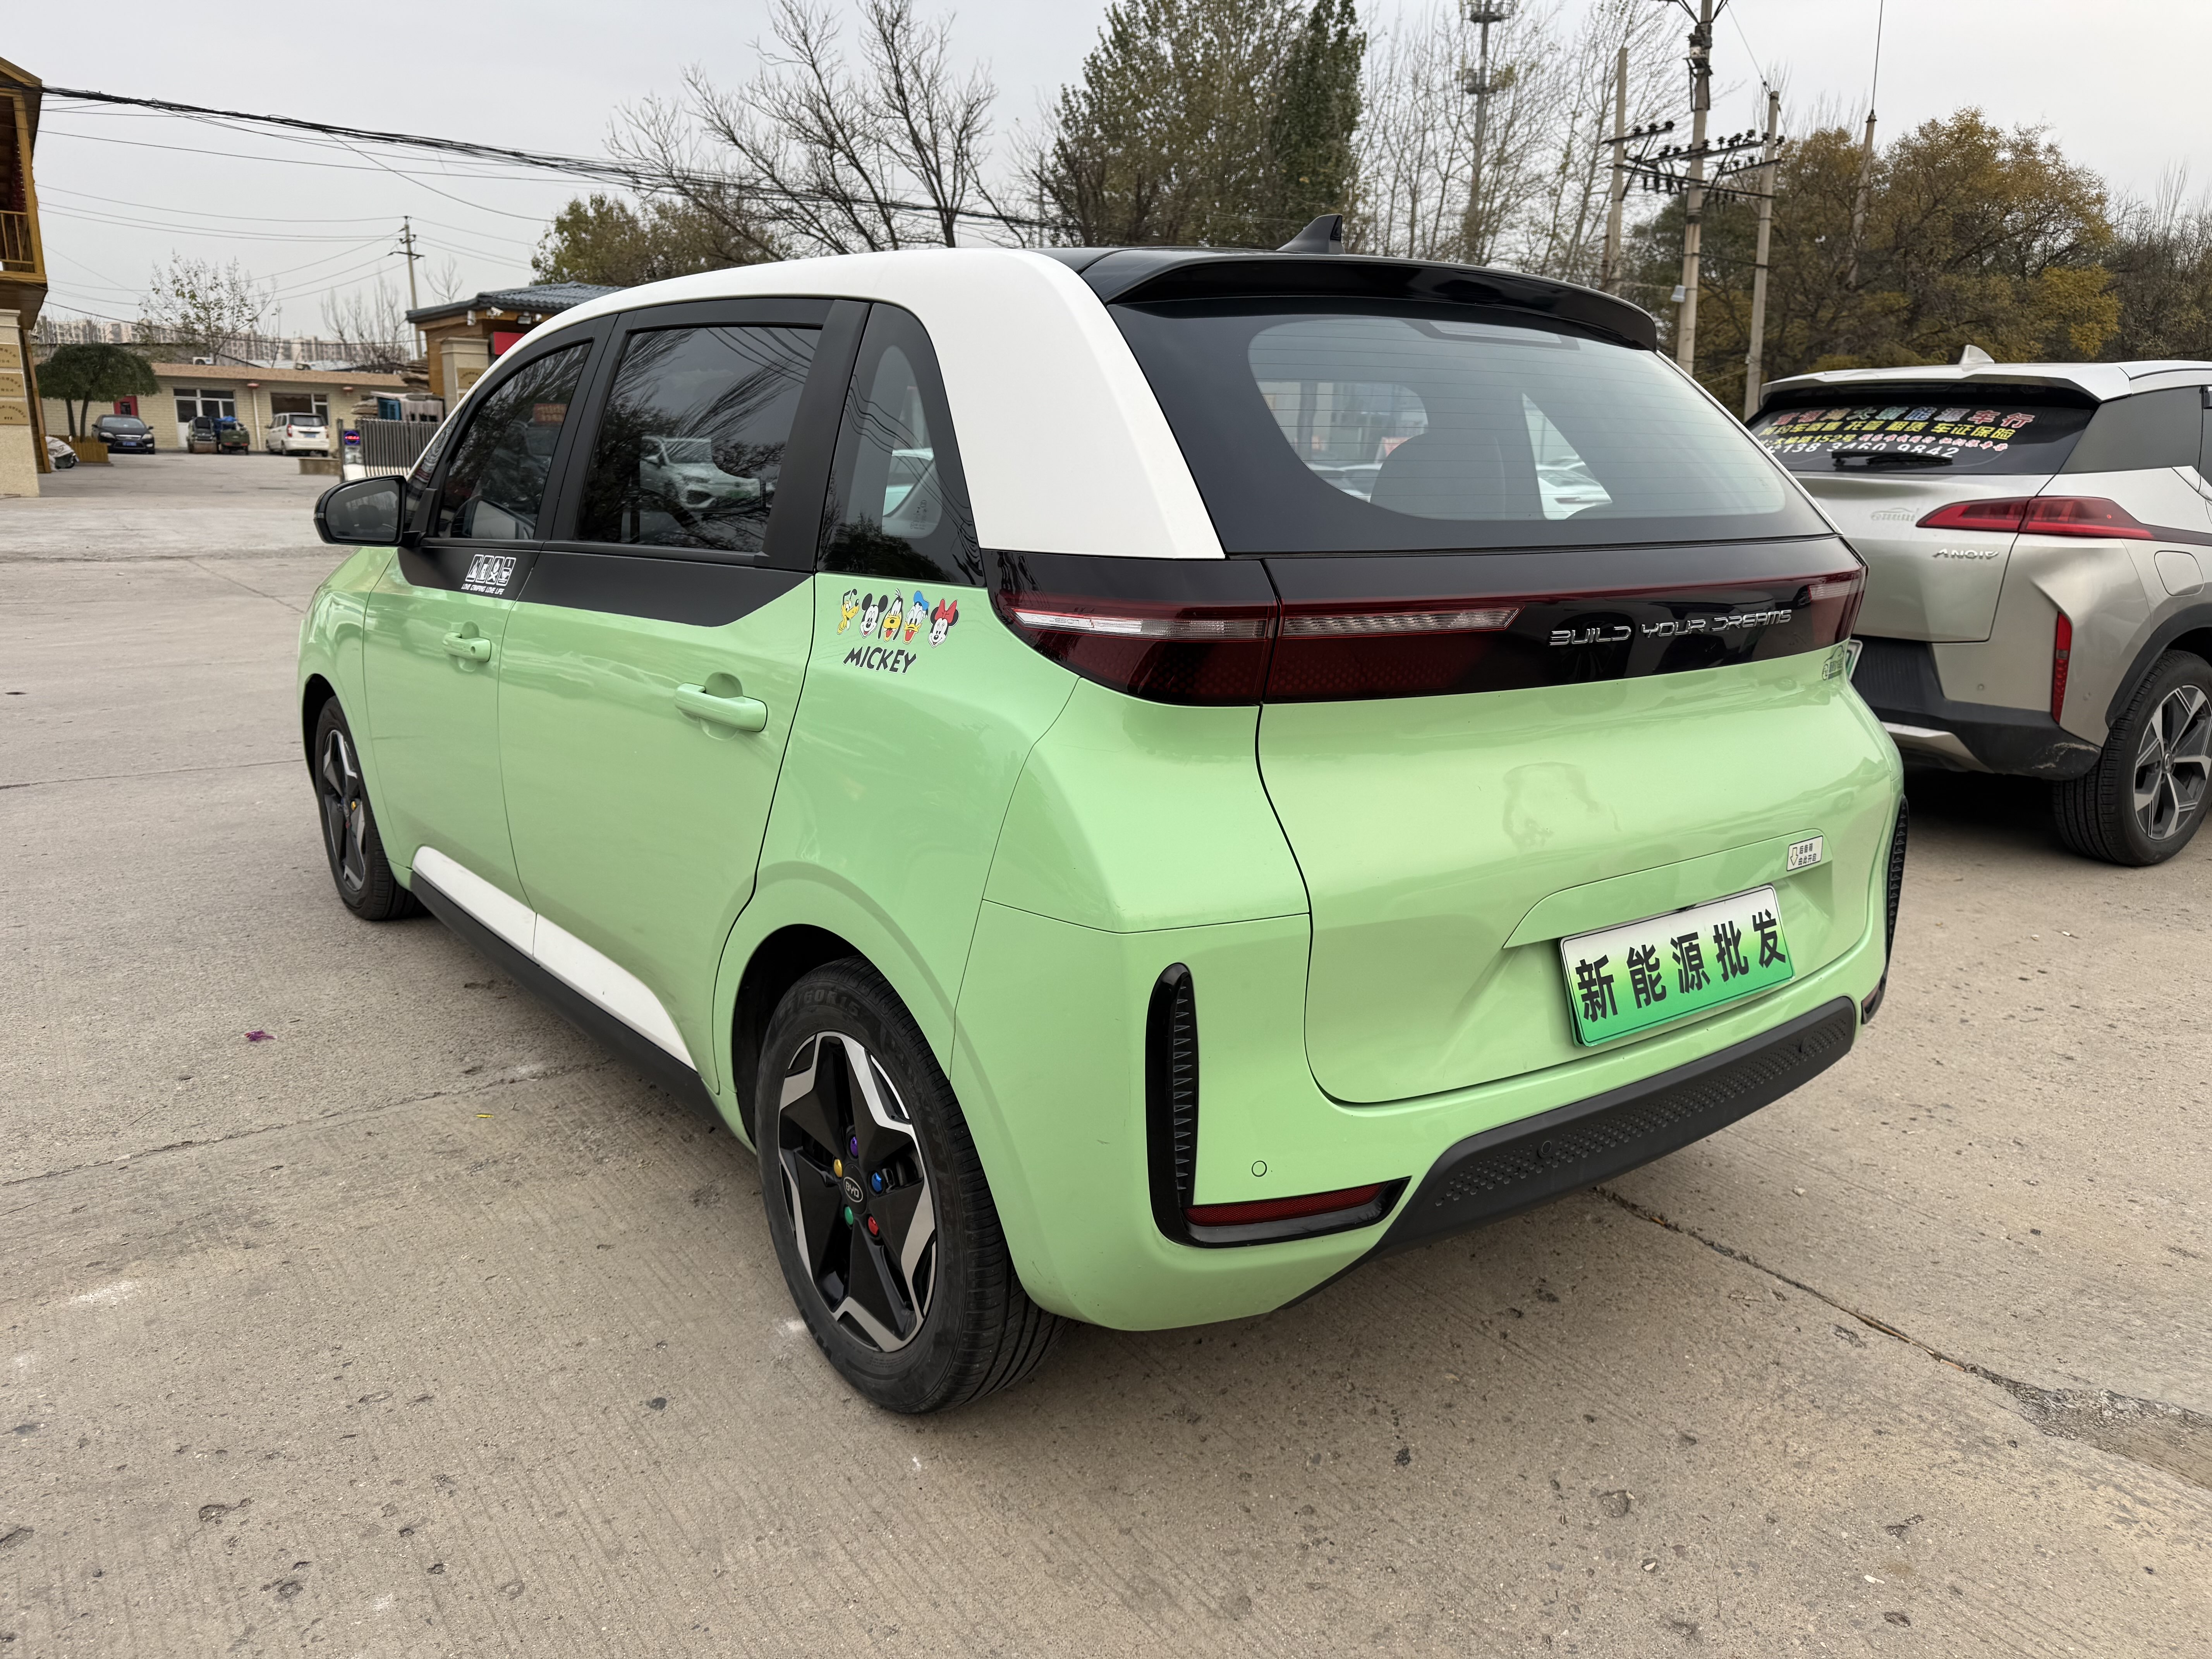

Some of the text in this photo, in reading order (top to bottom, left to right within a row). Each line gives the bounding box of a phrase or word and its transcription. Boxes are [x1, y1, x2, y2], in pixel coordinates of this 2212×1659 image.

[1931, 423, 2016, 440] 车证保险
[1783, 443, 1821, 453] 138
[1549, 609, 1792, 646] BUILD YOUR DREAMS
[843, 646, 917, 674] MICKEY
[1575, 908, 1786, 1023] 新能源批发
[845, 1181, 859, 1198] BYD
